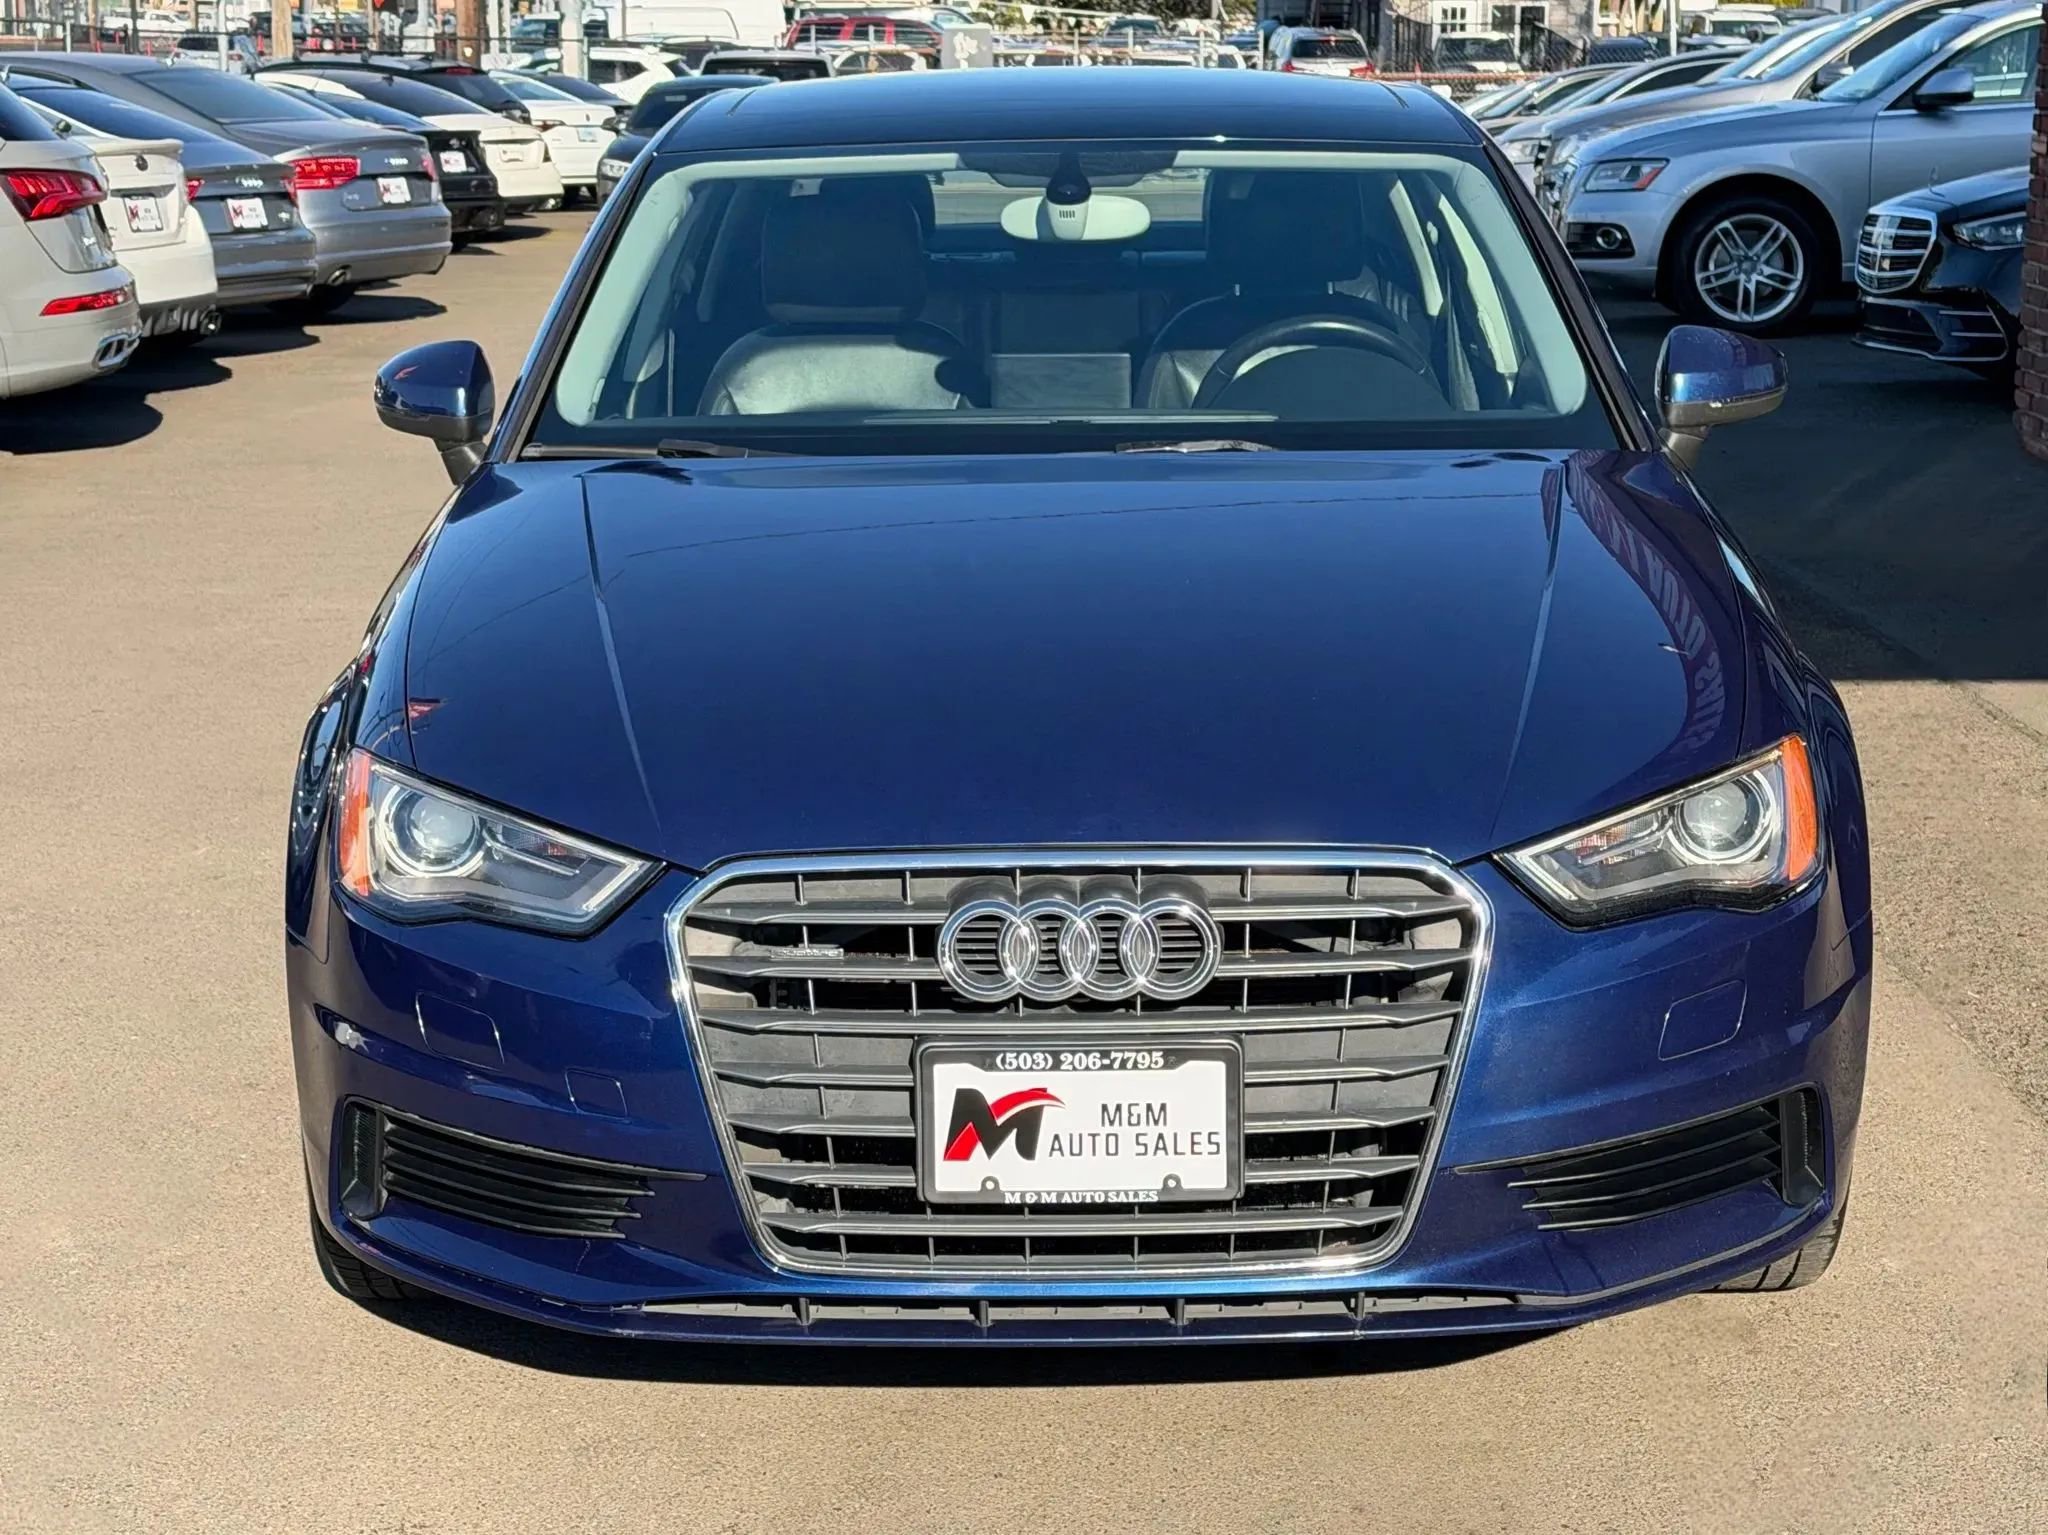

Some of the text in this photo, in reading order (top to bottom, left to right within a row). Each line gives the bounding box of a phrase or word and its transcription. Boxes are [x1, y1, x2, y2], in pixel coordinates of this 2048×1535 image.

[995, 1051, 1164, 1071] (503) 206-7795
[1101, 1102, 1167, 1127] M&M
[1049, 1131, 1221, 1157] AUTO SALES
[1004, 1190, 1158, 1203] M & M AUTO SALES
